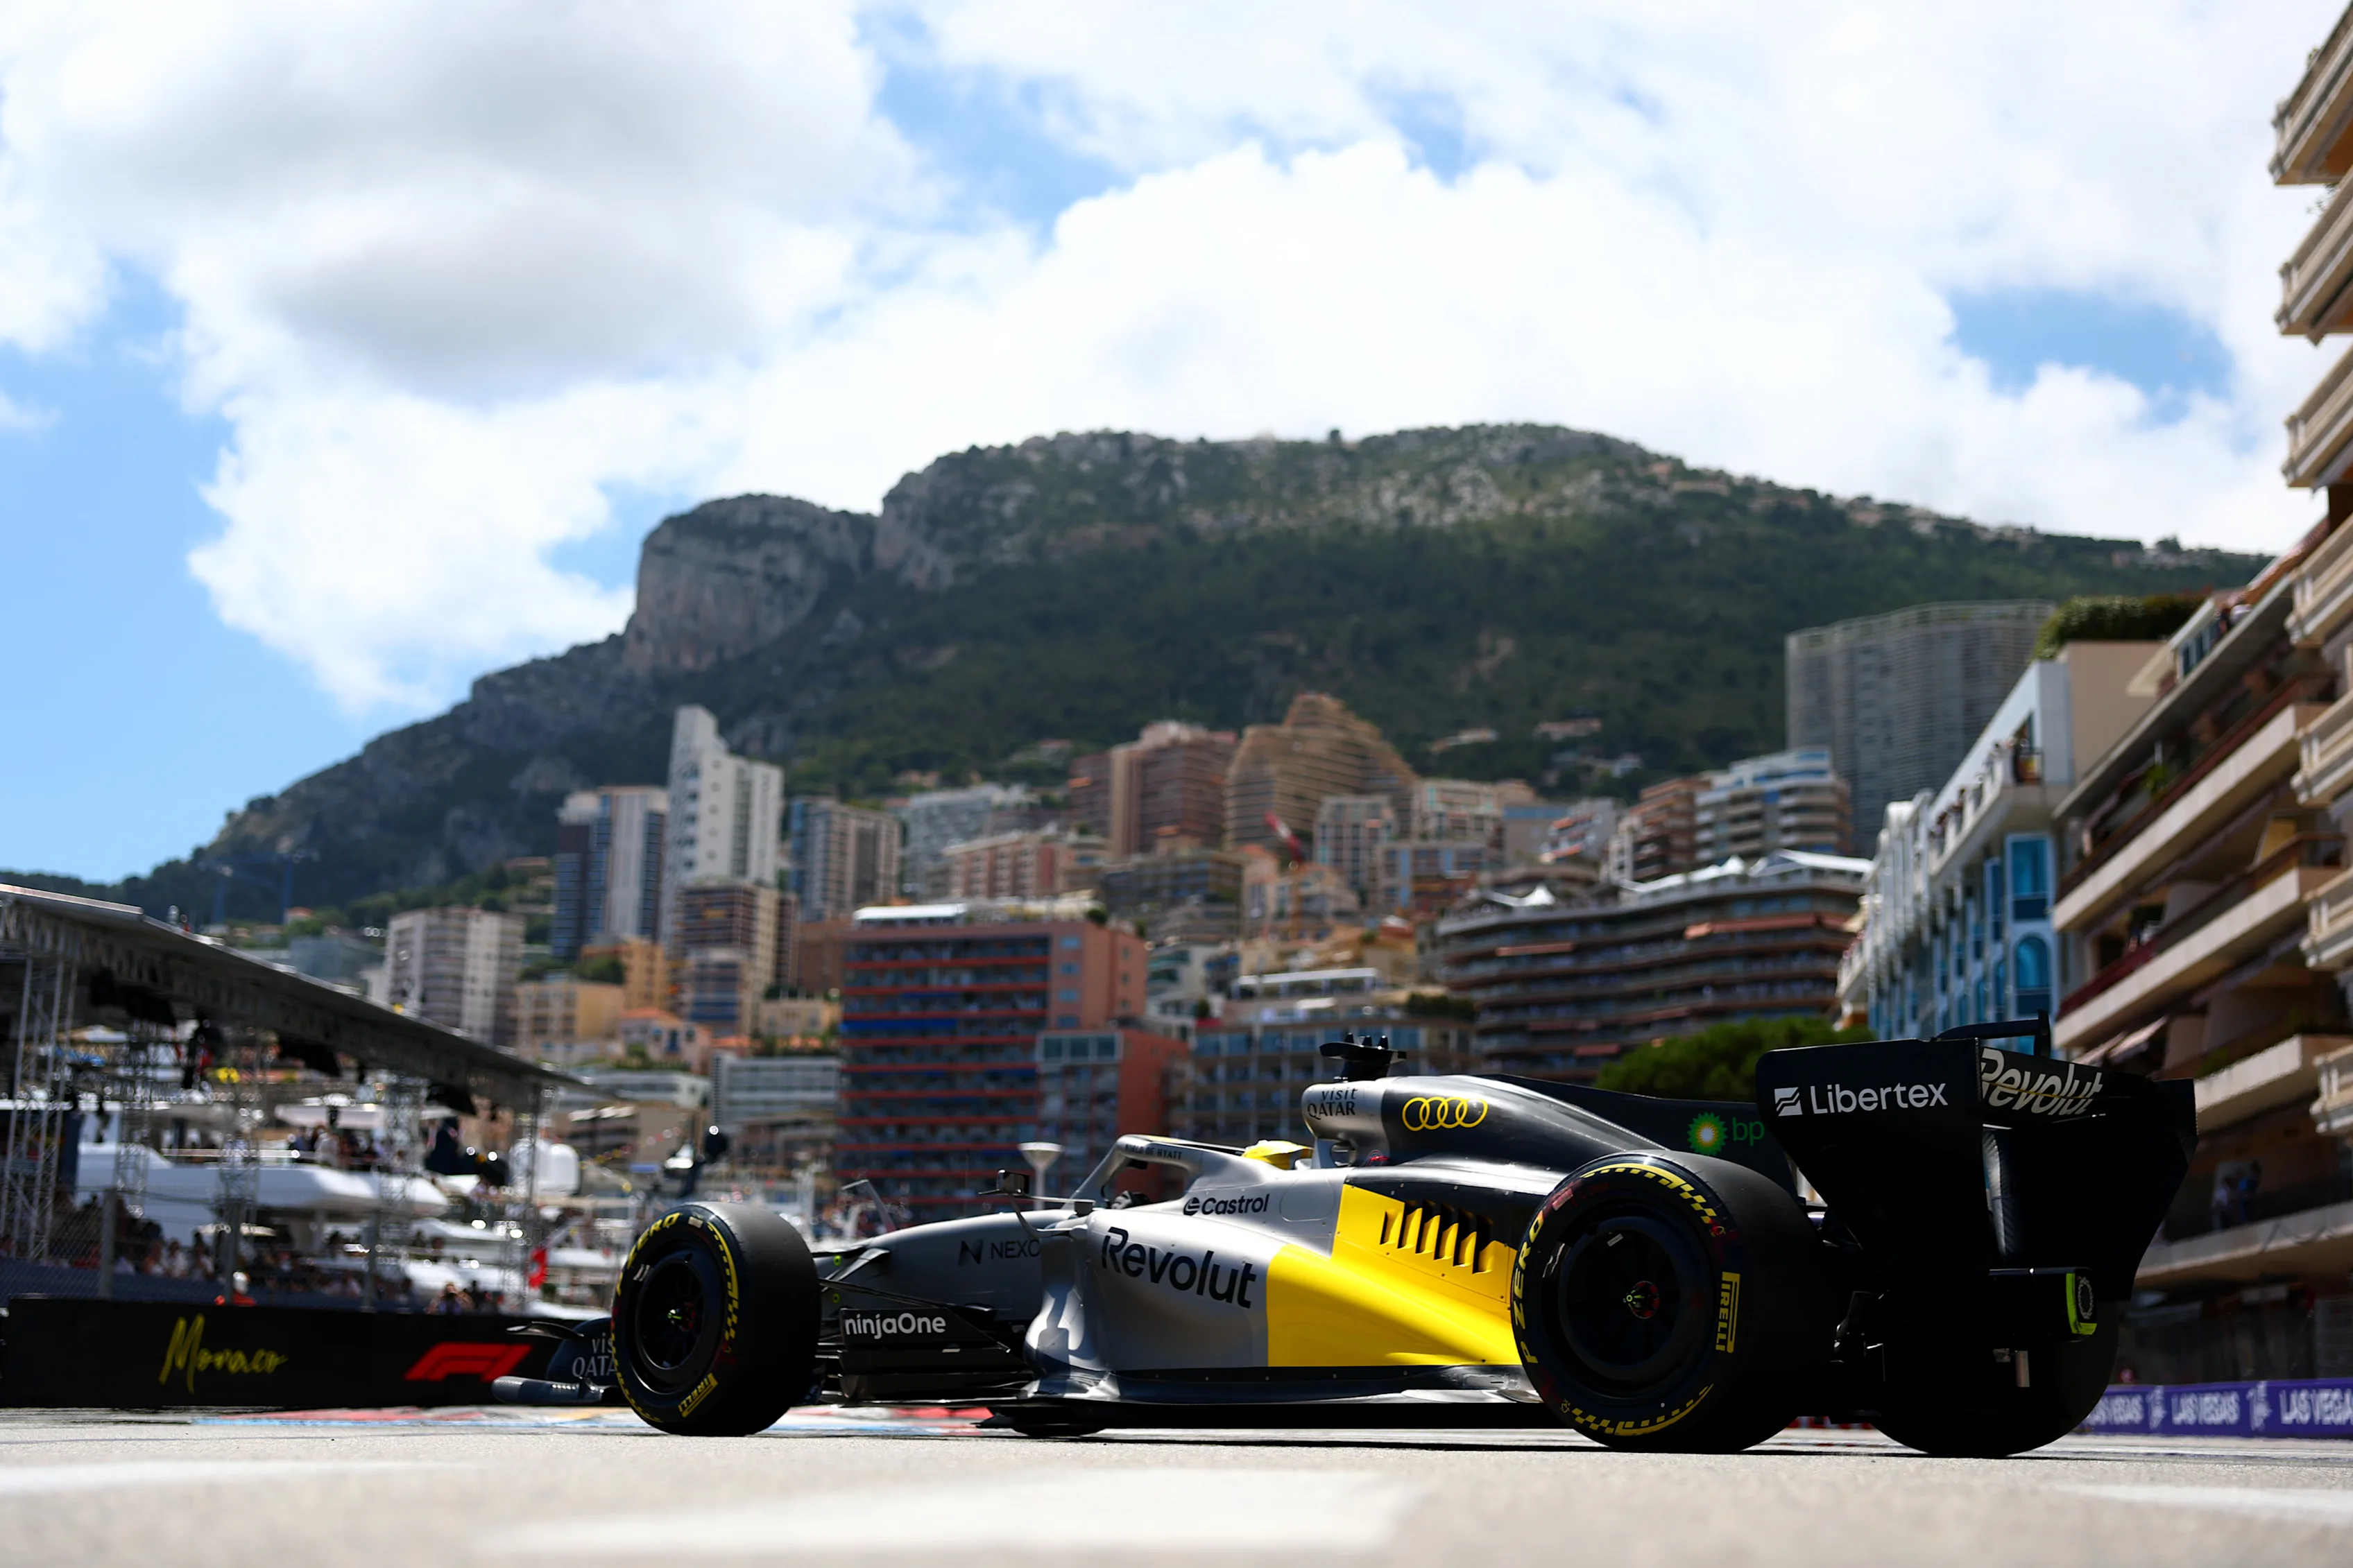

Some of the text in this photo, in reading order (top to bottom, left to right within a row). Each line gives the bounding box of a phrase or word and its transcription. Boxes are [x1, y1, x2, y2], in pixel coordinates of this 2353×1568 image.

[1321, 1087, 1358, 1101] visit
[1809, 1081, 1949, 1114] Libertex
[1980, 1047, 2104, 1116] Revolut
[1307, 1101, 1356, 1120] QATAR
[1731, 1115, 1765, 1146] bp
[1157, 1148, 1183, 1160] HYATT
[1201, 1194, 1270, 1216] Castrol
[1101, 1227, 1256, 1309] Revolut
[1512, 1209, 1545, 1365] P ZERO
[844, 1313, 947, 1340] ninjaOne
[1715, 1270, 1741, 1354] PIRELLI
[158, 1311, 289, 1395] Monaco
[591, 1332, 615, 1354] vis
[572, 1355, 619, 1378] QATA
[677, 1372, 719, 1418] PIRELLI
[2279, 1388, 2353, 1425] LAS VEGA
